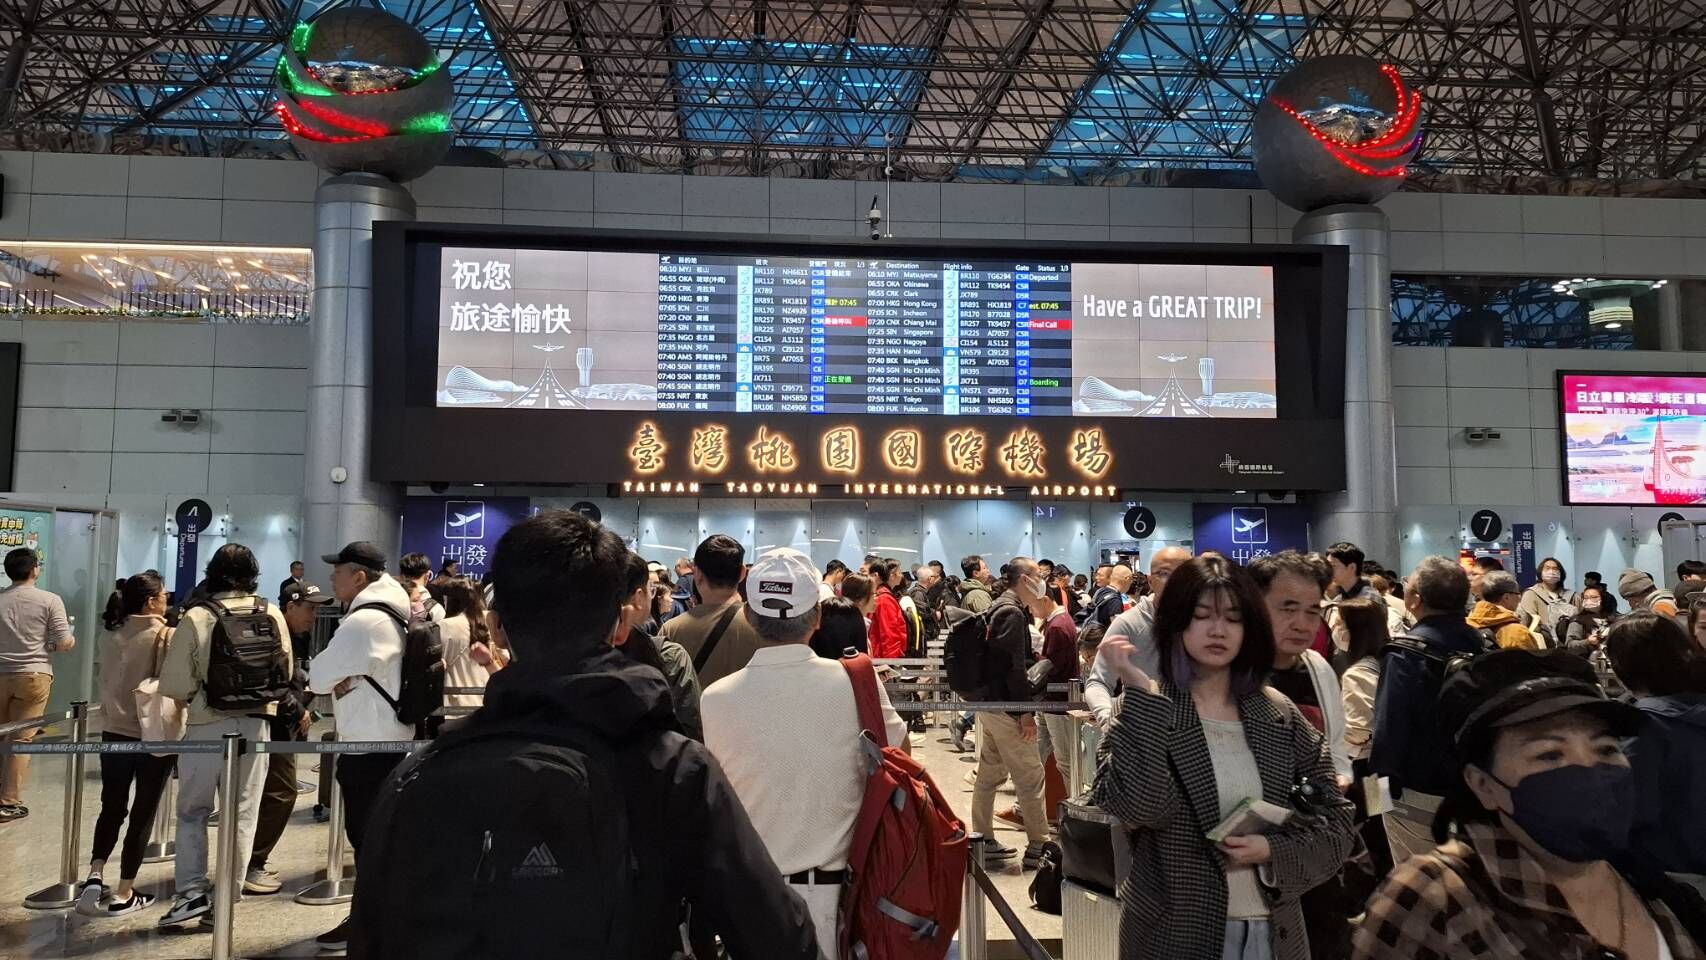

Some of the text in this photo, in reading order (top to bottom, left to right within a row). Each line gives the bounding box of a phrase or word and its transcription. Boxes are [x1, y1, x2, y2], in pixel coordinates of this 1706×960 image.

[451, 259, 512, 291] 祝您
[944, 263, 960, 271] Flight
[1083, 294, 1262, 319] Have a GREAT TRIP!
[450, 301, 572, 334] 旅途愉快
[904, 329, 933, 337] Singapore
[904, 358, 929, 366] Bangkok
[1030, 379, 1059, 387] Boarding
[631, 423, 1110, 474] 臺灣桃園國際機場
[624, 482, 1117, 496] TAIWAN TAOYUAN INTERNATIONAL AIRPORT
[1133, 512, 1147, 533] 6
[1480, 516, 1493, 536] 7
[442, 544, 488, 566] 出發
[760, 582, 791, 593] Titleist
